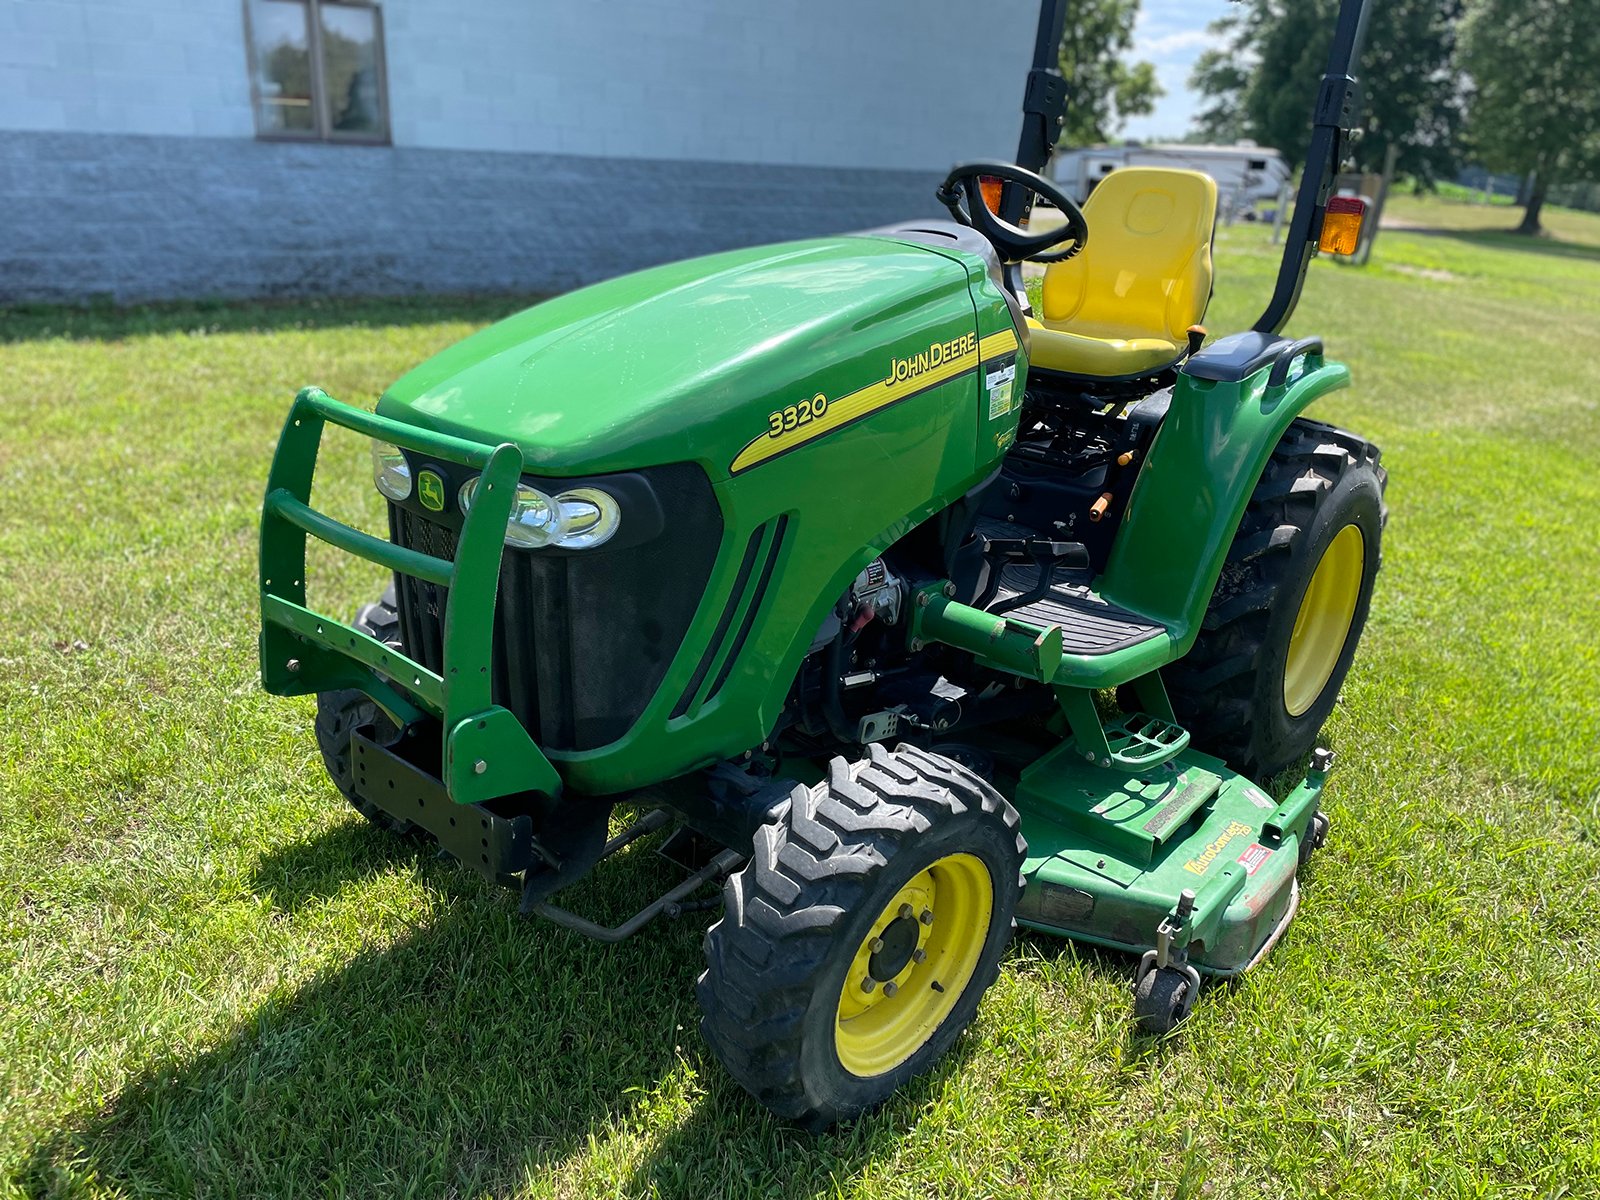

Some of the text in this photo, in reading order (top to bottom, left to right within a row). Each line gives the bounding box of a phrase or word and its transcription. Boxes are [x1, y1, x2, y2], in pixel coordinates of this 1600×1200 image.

[885, 332, 976, 386] JOHN DEERE
[768, 393, 827, 438] 3320
